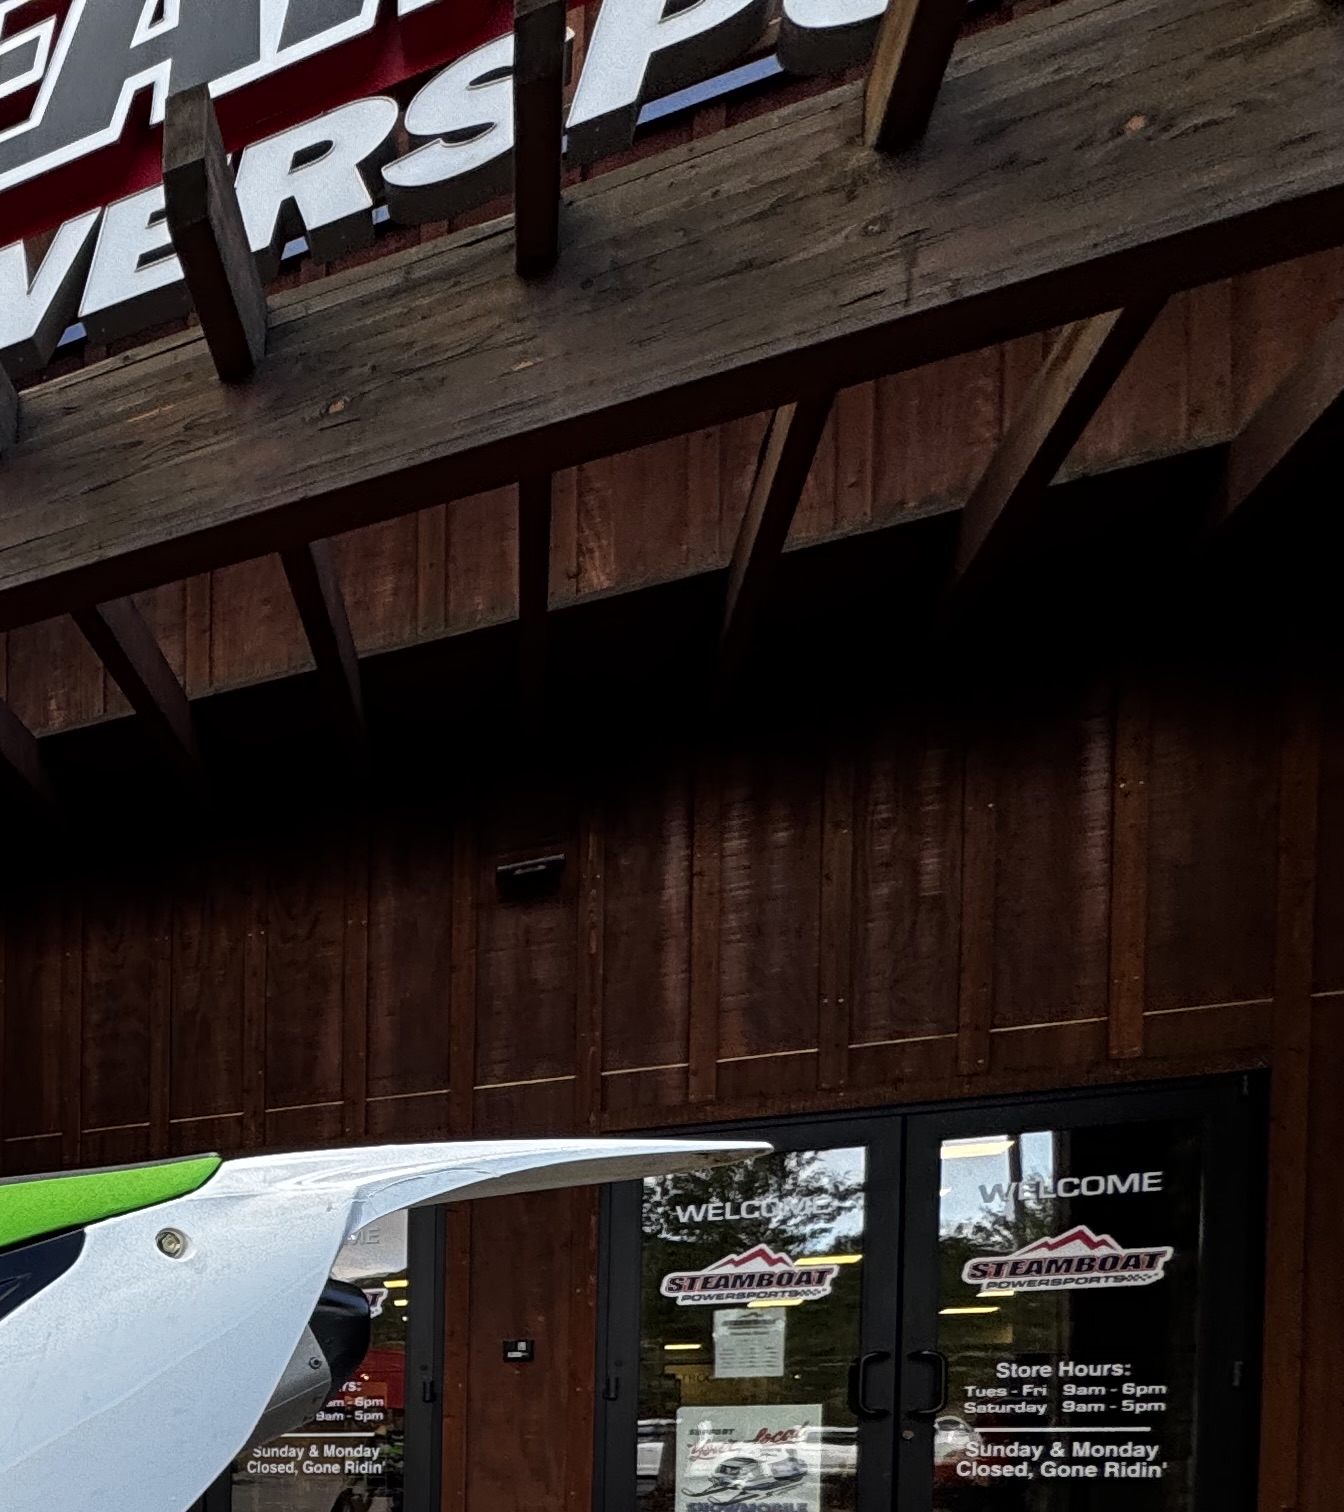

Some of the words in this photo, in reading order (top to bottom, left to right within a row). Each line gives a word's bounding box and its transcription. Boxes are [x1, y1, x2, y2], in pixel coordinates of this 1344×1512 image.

[979, 1171, 1163, 1203] WELCOME
[676, 1195, 832, 1223] WELCOME
[967, 1250, 1169, 1280] STEAMBOAT
[666, 1267, 835, 1294] STEAMBOAT
[986, 1275, 1126, 1290] POWERSPORTS
[681, 1289, 801, 1303] POWERSPORTS
[996, 1362, 1052, 1378] Store
[1058, 1361, 1131, 1377] Hours:
[964, 1385, 1007, 1397] Tues
[1022, 1384, 1047, 1396] Fri
[1062, 1384, 1106, 1396] 9am
[1122, 1383, 1167, 1397] 6pm
[354, 1397, 384, 1408] 6pm
[964, 1402, 1047, 1415] Saturday
[1062, 1400, 1105, 1412] 9am
[1121, 1400, 1166, 1414] 5pm
[354, 1411, 384, 1423] 5pm
[253, 1445, 305, 1460] Sunday
[309, 1444, 319, 1458] &
[323, 1444, 381, 1460] Monday
[965, 1441, 1044, 1461] Sunday
[1050, 1441, 1065, 1457] &
[1072, 1441, 1159, 1461] Monday
[247, 1461, 298, 1476] Closed,
[303, 1461, 340, 1475] Gone
[344, 1460, 386, 1475] Ridin'
[956, 1461, 1033, 1479] Closed,
[1040, 1461, 1098, 1478] Gone
[1104, 1461, 1168, 1478] Ridin'
